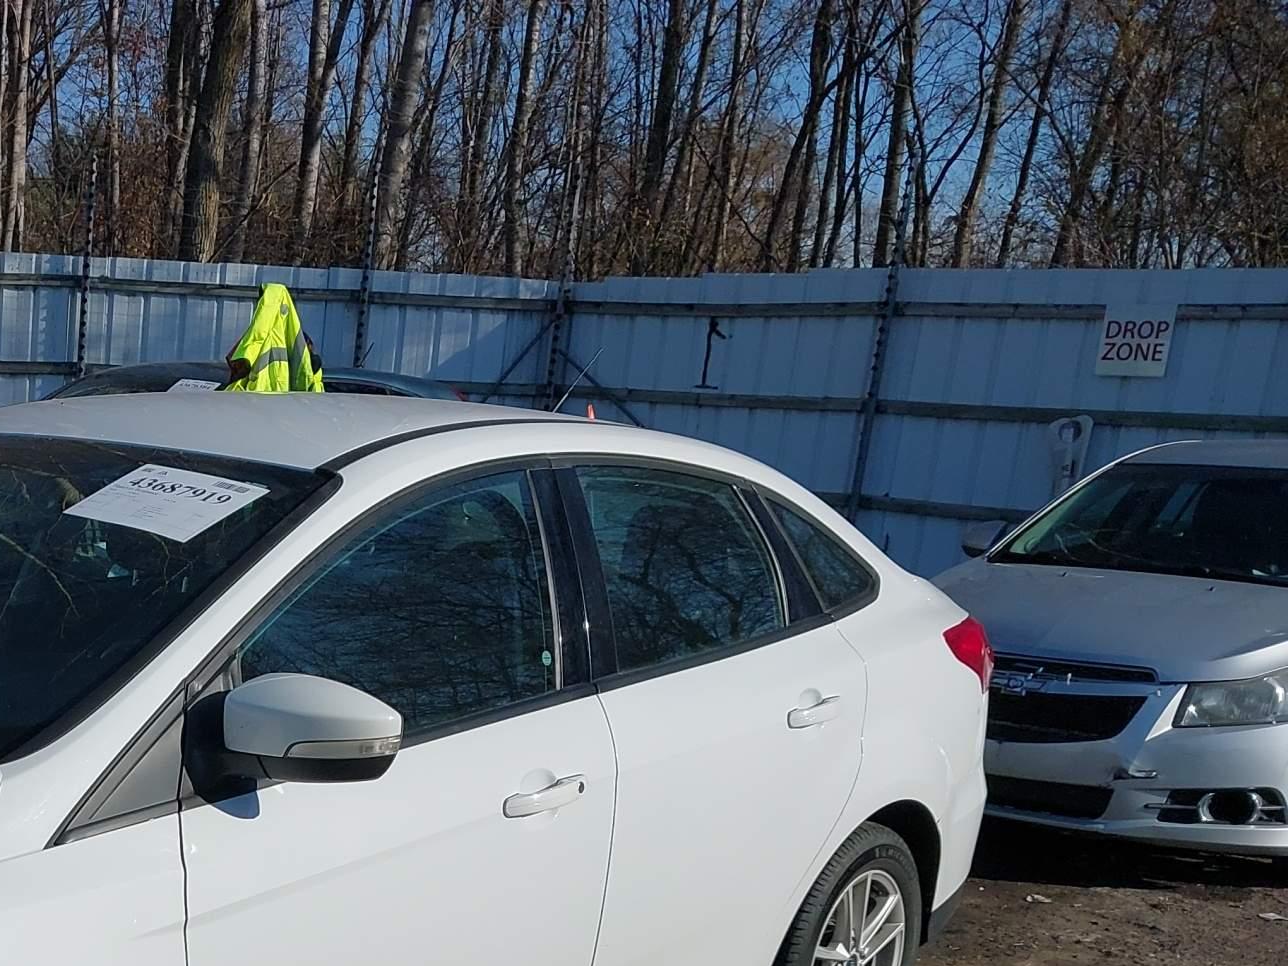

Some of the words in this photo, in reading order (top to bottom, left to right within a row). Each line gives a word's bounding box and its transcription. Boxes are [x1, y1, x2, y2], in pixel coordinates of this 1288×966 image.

[1105, 320, 1170, 339] DROP
[1101, 342, 1165, 362] ZONE
[128, 476, 233, 505] 43687919
